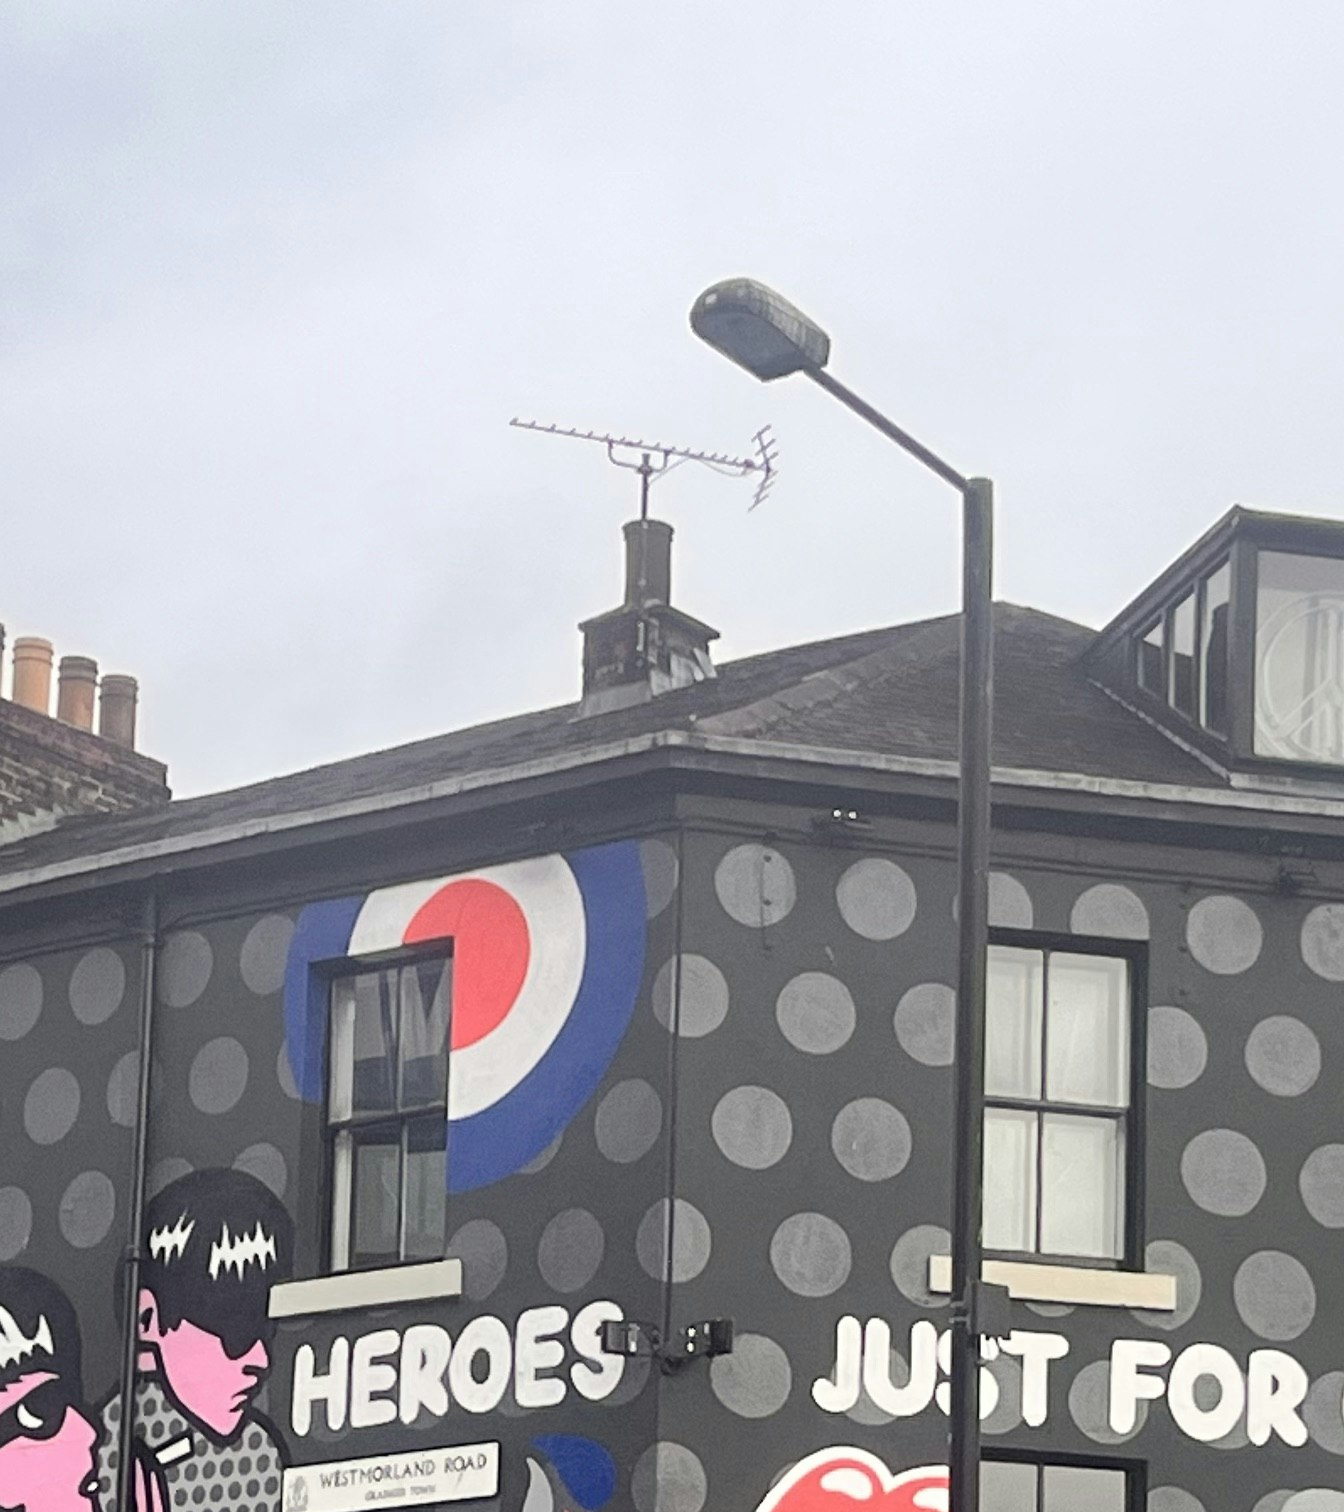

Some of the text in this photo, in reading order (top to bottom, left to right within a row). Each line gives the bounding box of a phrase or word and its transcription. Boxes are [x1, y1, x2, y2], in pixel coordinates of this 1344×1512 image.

[291, 1299, 625, 1437] HEROES
[1109, 1338, 1309, 1448] FOR
[319, 1452, 488, 1488] WESTMORLAND ROAD
